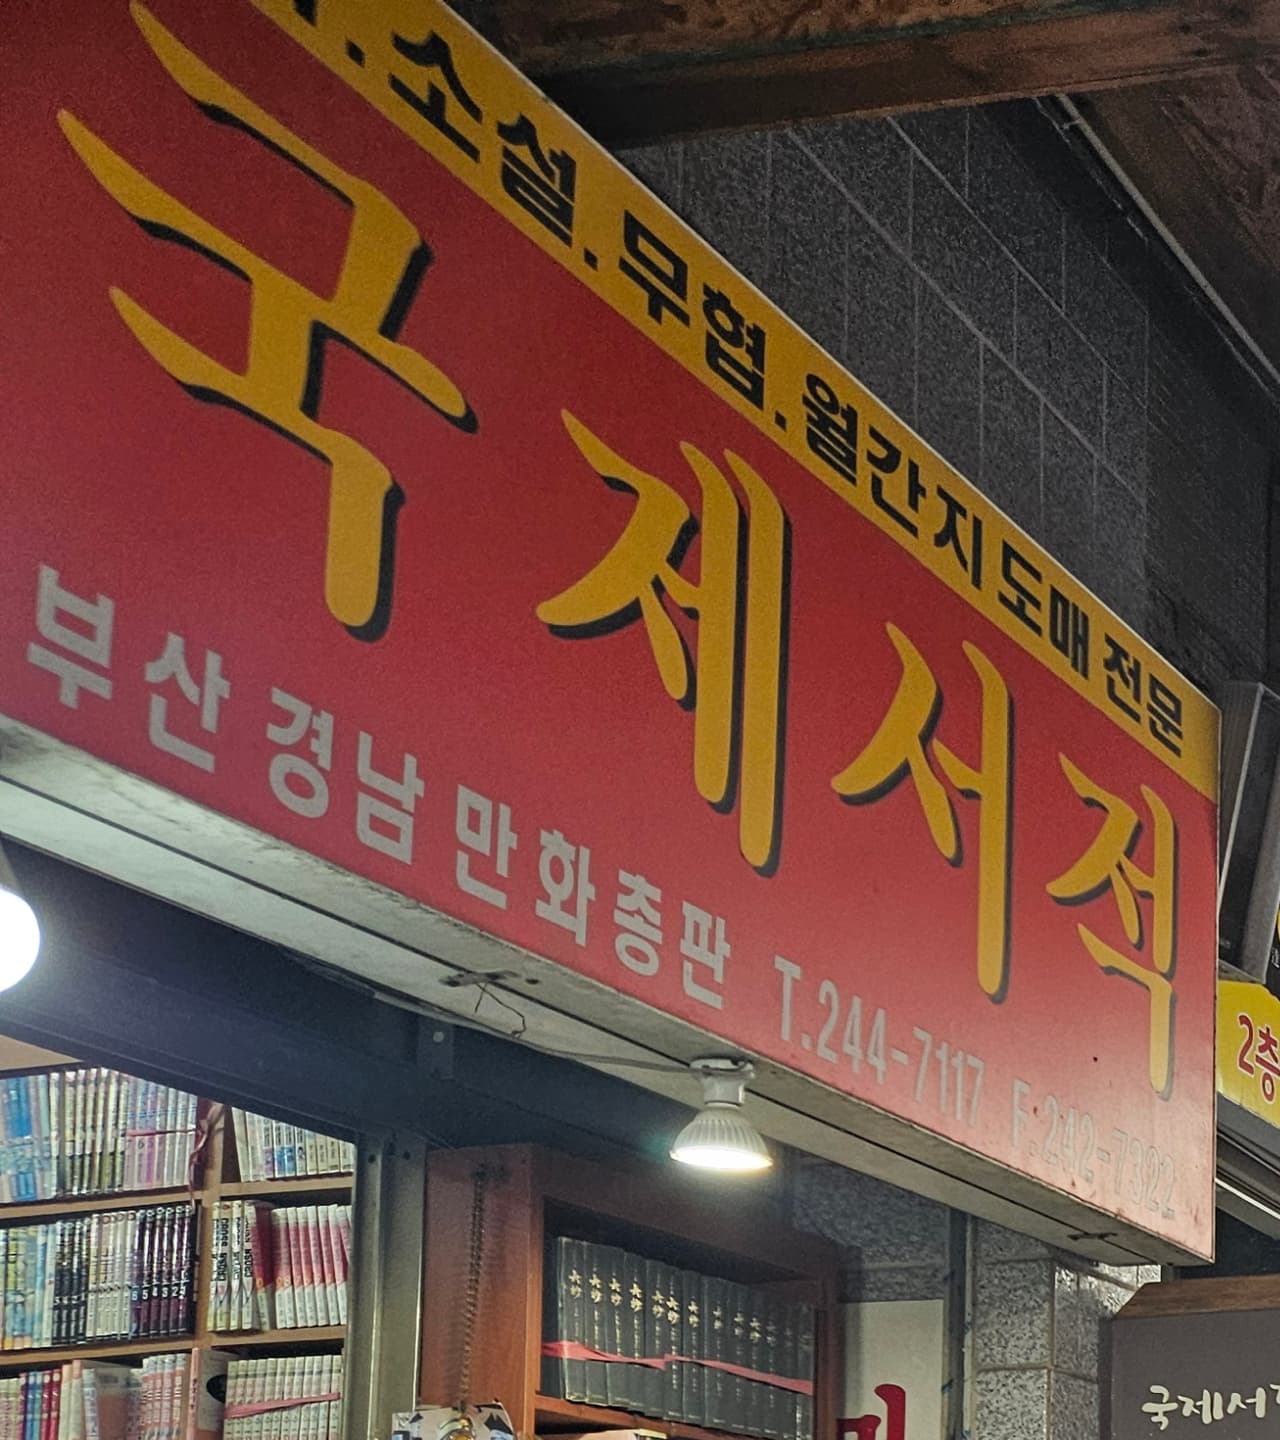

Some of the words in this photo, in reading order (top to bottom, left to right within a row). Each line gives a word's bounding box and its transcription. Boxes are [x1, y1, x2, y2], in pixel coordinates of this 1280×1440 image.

[57, 0, 1177, 1101] 국제서적
[1103, 632, 1184, 758] 전문
[26, 564, 231, 773] 부산
[266, 687, 425, 865] 경남
[773, 954, 986, 1128] T.244-7117
